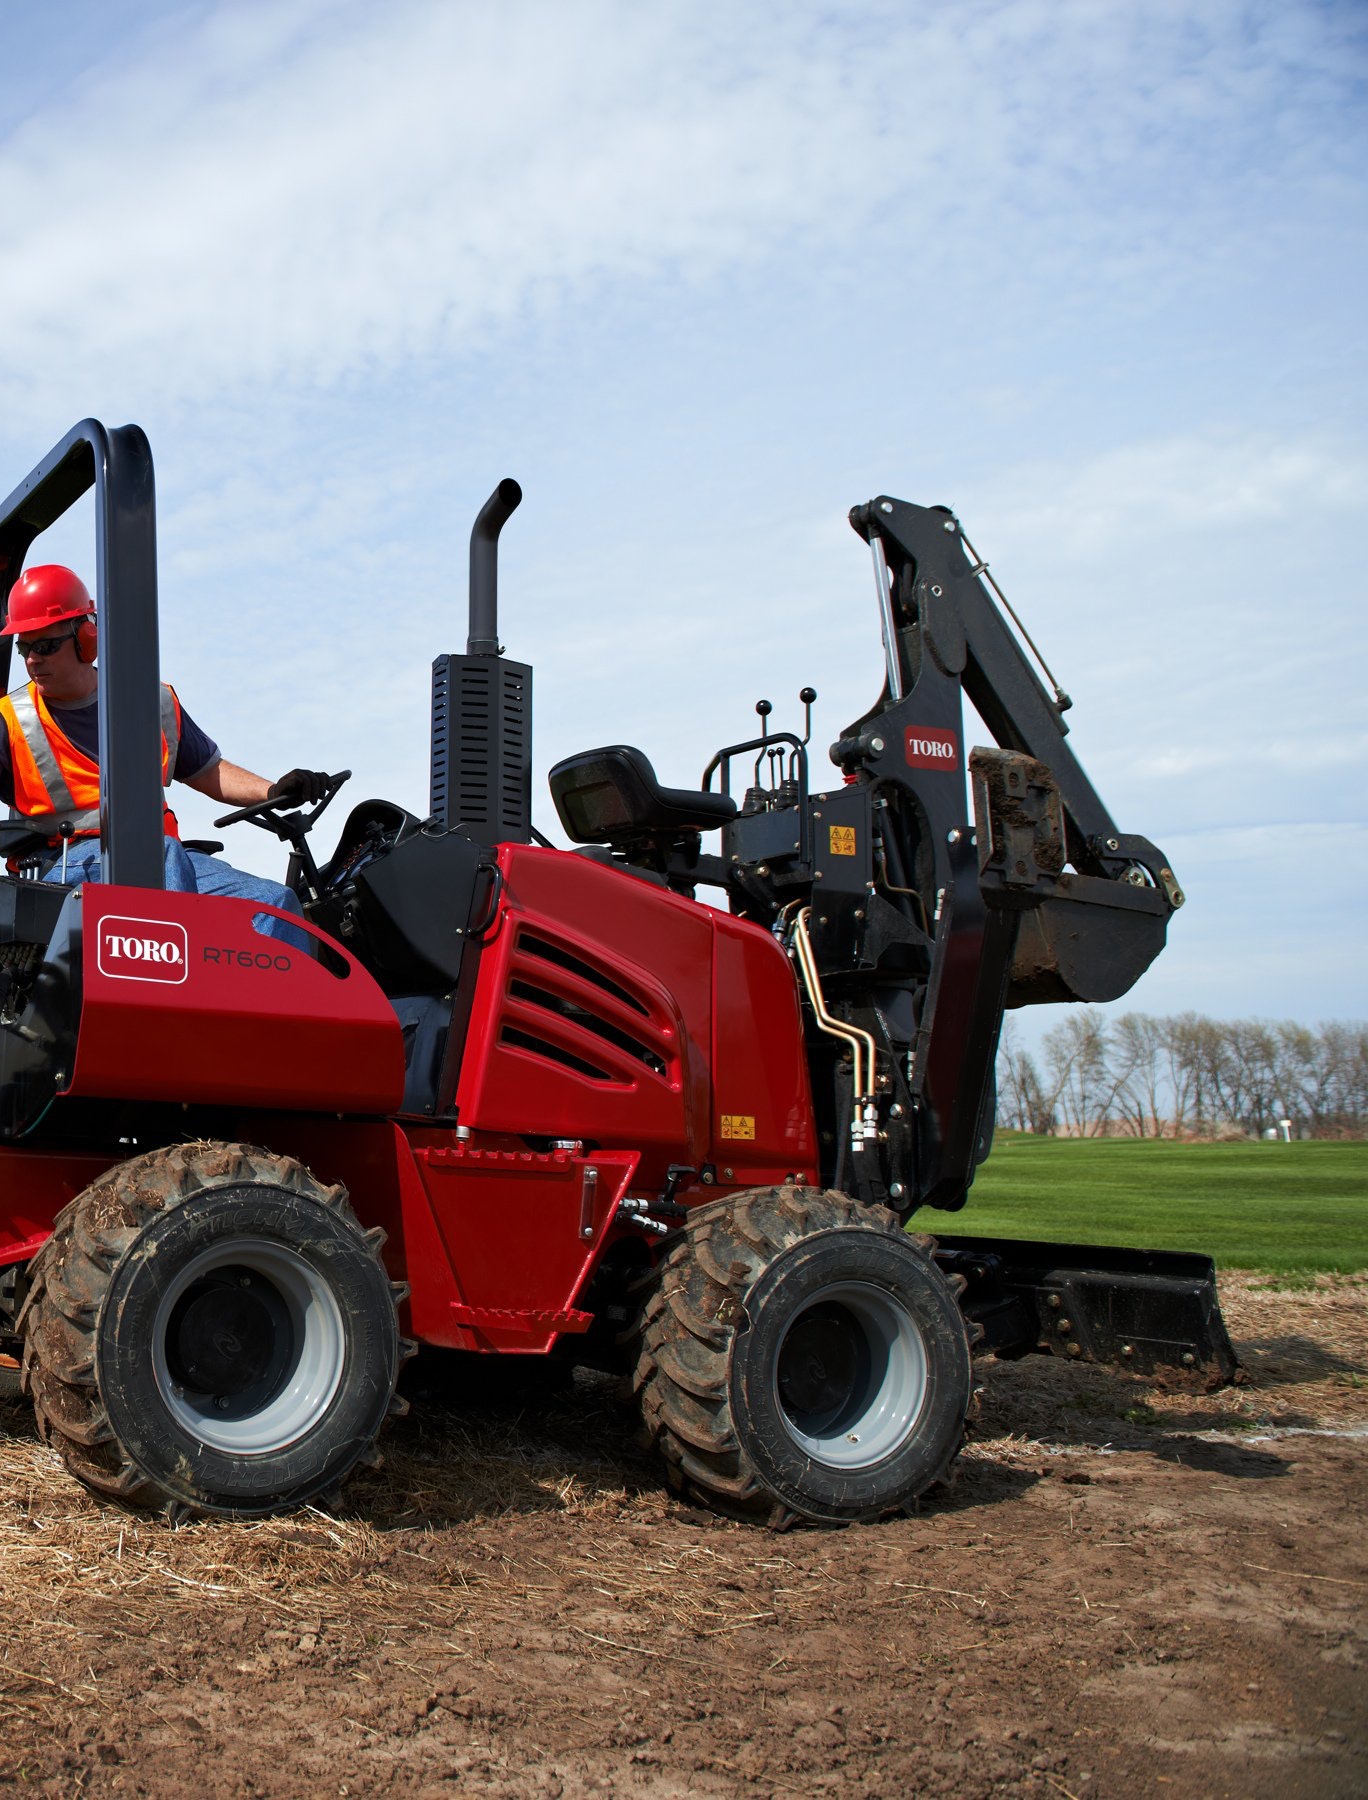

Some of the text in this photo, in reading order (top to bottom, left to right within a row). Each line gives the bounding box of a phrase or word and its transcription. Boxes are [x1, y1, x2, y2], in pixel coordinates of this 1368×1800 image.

[909, 738, 953, 759] TORO
[105, 935, 292, 972] TORO RT600
